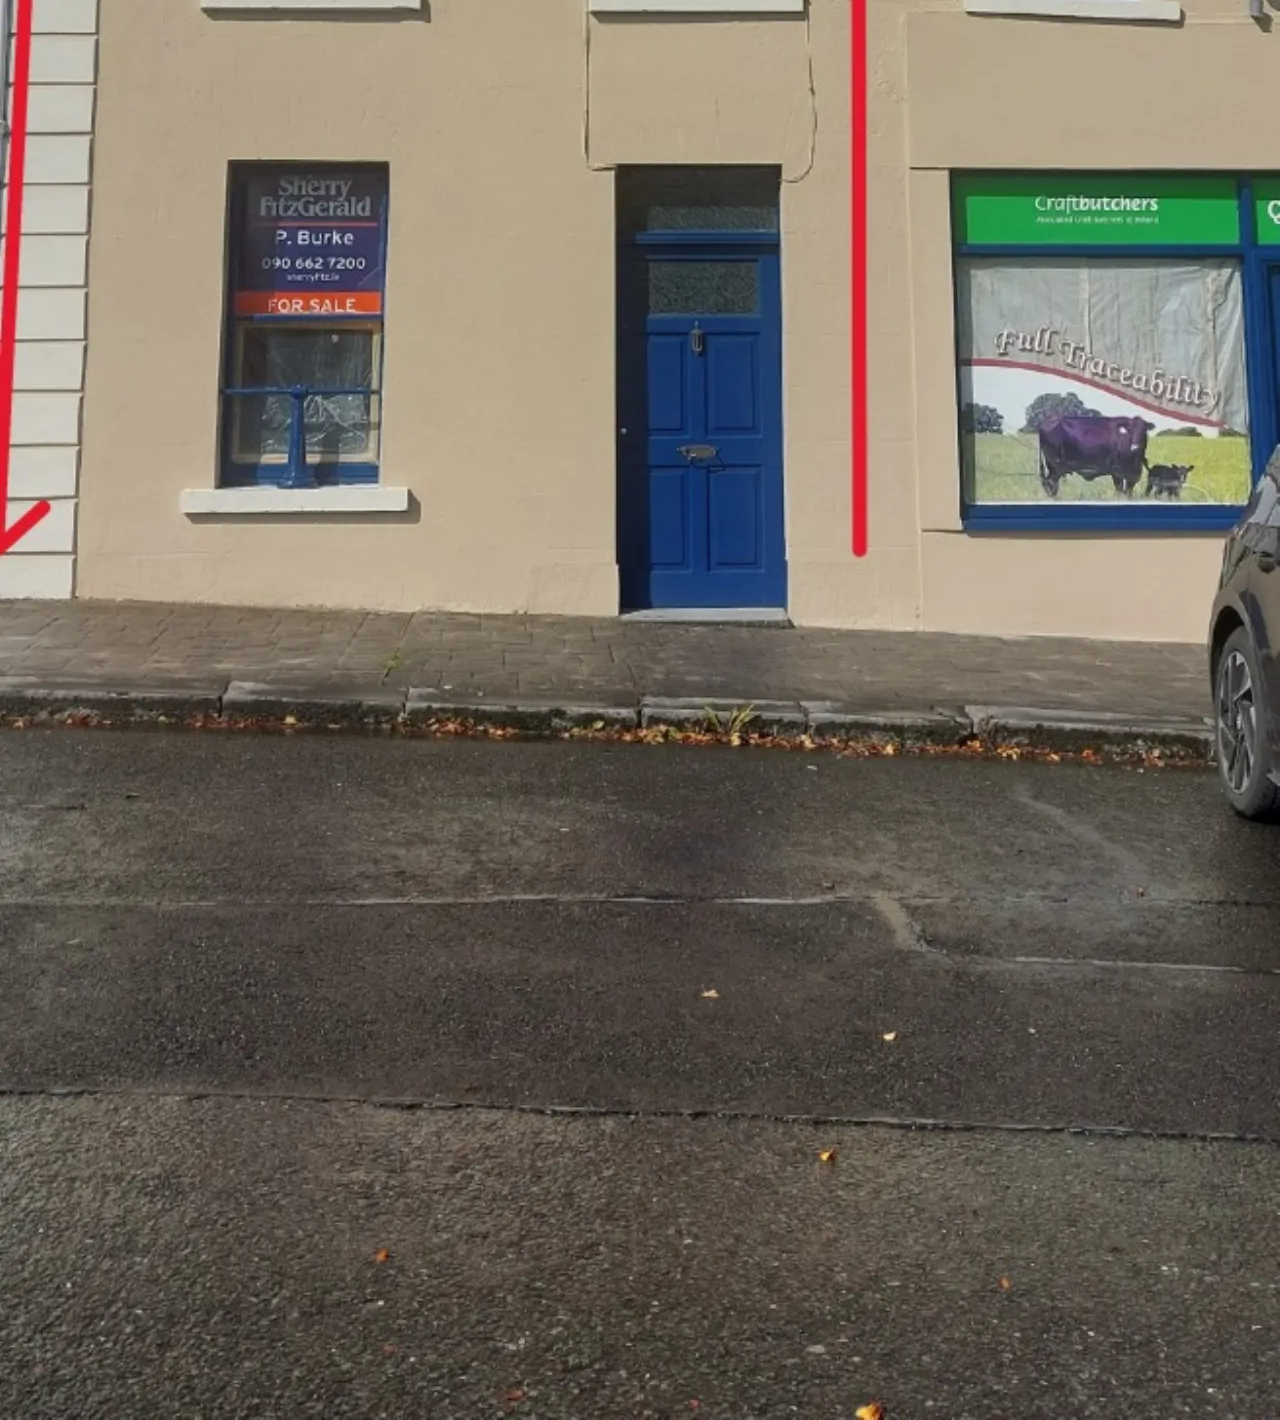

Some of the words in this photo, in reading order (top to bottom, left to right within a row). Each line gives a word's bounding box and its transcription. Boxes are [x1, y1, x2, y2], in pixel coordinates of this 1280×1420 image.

[278, 176, 352, 200] Sherry
[260, 196, 372, 217] FitzGerald
[1035, 194, 1159, 215] Craftbutchers
[276, 230, 292, 245] P.
[297, 229, 354, 245] Burke
[262, 257, 291, 269] 090
[295, 257, 323, 269] 662
[328, 257, 366, 269] 7200
[268, 299, 303, 313] FOR
[309, 299, 356, 313] SALE
[995, 326, 1059, 356] Full
[1059, 339, 1221, 414] Traceability
